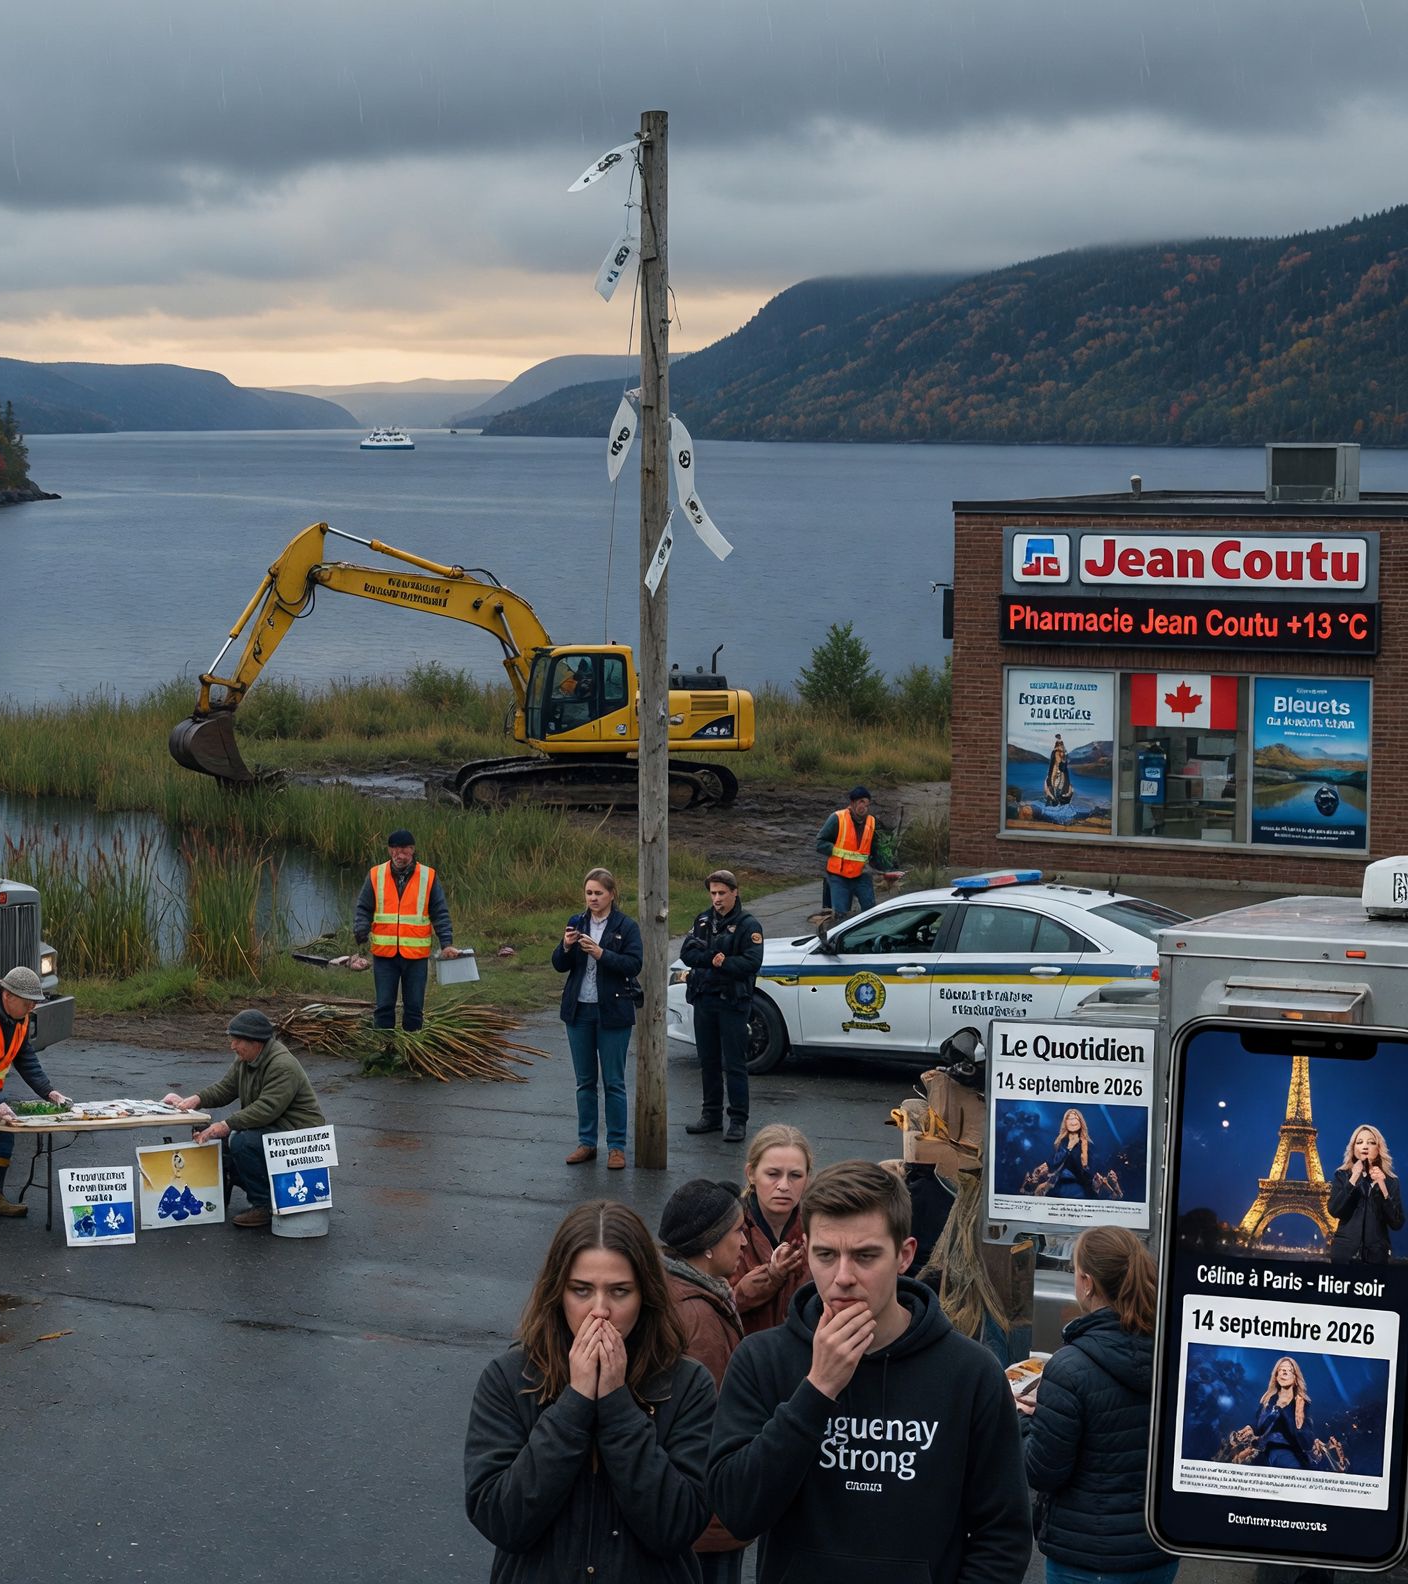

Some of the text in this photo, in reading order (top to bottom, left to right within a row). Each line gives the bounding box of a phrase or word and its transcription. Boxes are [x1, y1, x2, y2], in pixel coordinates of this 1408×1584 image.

[1085, 540, 1359, 581] Jean Coutu
[1009, 605, 1134, 633] Pharmacie
[1140, 609, 1198, 634] Jean
[1205, 609, 1279, 637] Coutu
[1286, 613, 1332, 639] +13
[1273, 696, 1351, 715] Bleuets
[1000, 1034, 1145, 1063] Le Quotidien
[996, 1072, 1143, 1096] 14 septembre 2026
[1196, 1264, 1245, 1285] Céline
[1248, 1269, 1259, 1287] à
[1263, 1271, 1303, 1290] Paris
[1317, 1275, 1351, 1294] Hier
[1353, 1279, 1386, 1297] soir
[1192, 1309, 1375, 1345] 14 septembre 2026
[819, 1437, 917, 1480] Strong
